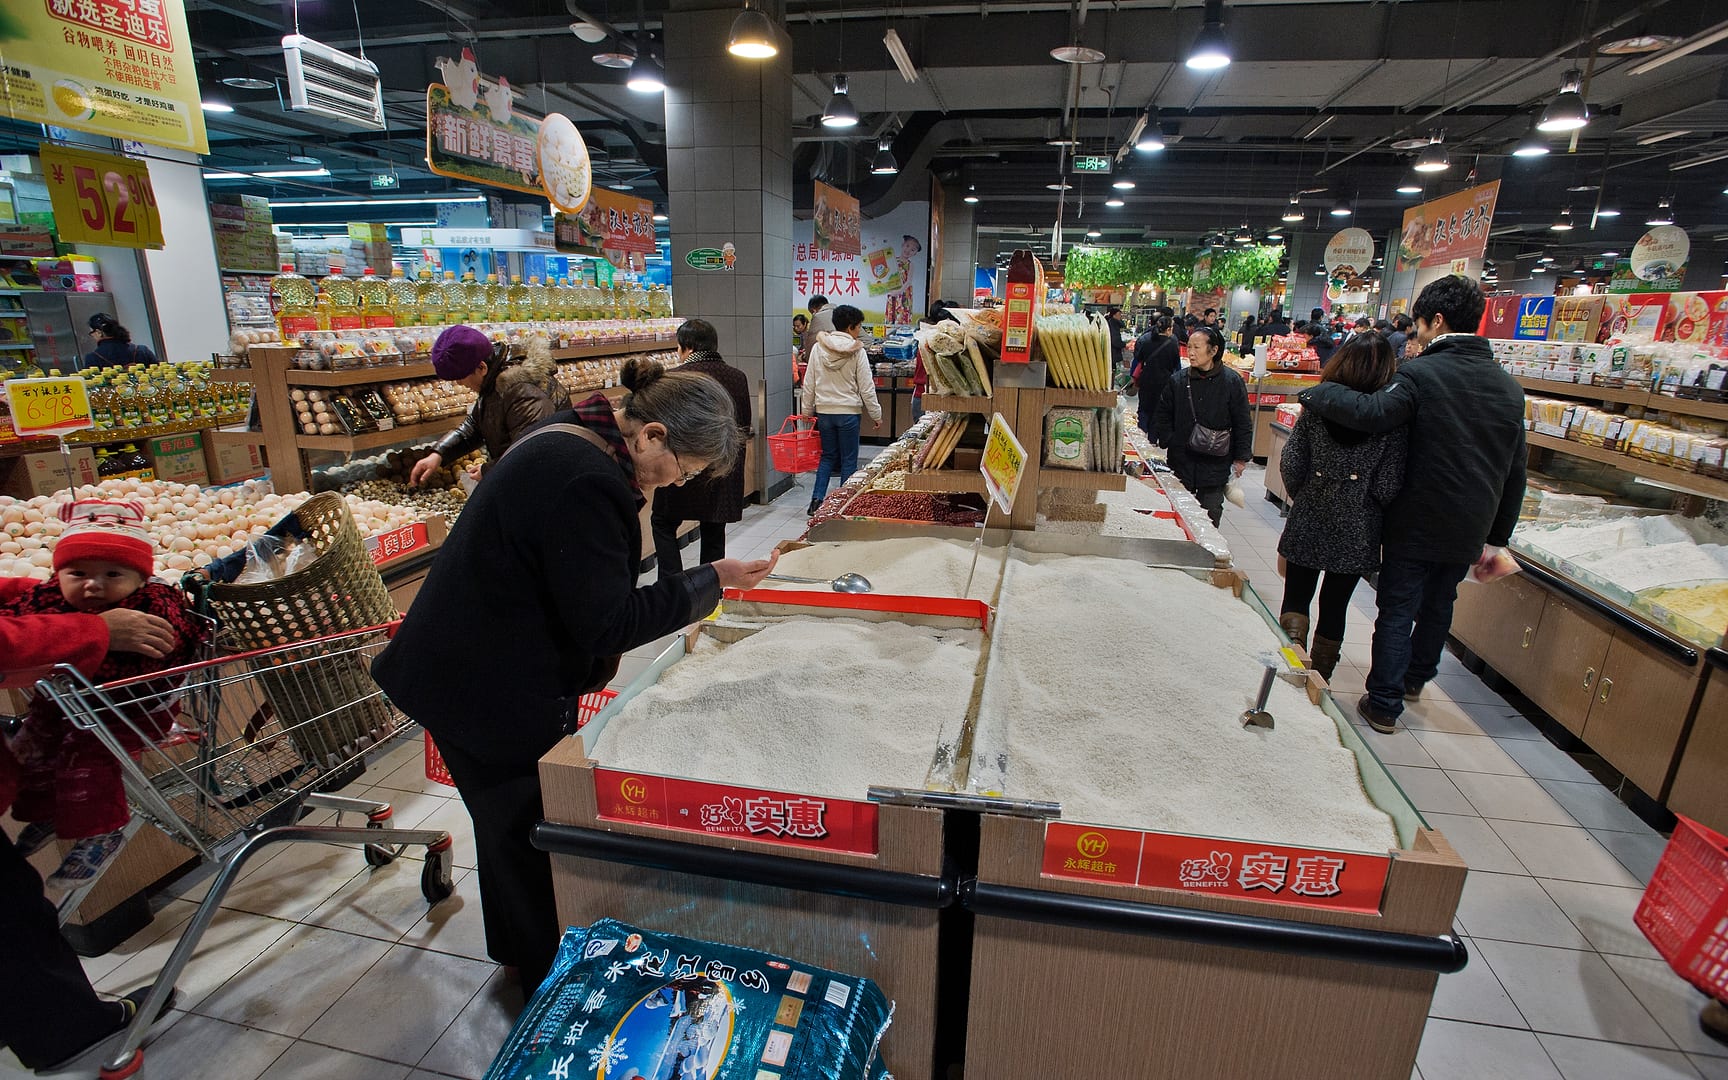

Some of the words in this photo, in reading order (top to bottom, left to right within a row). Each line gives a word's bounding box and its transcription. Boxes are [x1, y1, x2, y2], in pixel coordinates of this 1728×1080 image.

[53, 0, 168, 45] 就选圣迪乐
[63, 27, 117, 56] 谷物喂养
[124, 44, 174, 72] 回归自然
[105, 69, 162, 92] 不使用抗生素
[135, 95, 176, 112] 才是好鸡蛋
[794, 268, 860, 296] 专用大米
[28, 396, 74, 423] 6.98
[626, 785, 645, 799] YH
[615, 803, 659, 820] 永辉超市
[1084, 838, 1106, 853] YH
[1064, 857, 1117, 873] 永辉超市
[548, 960, 632, 1080] 长粒香米
